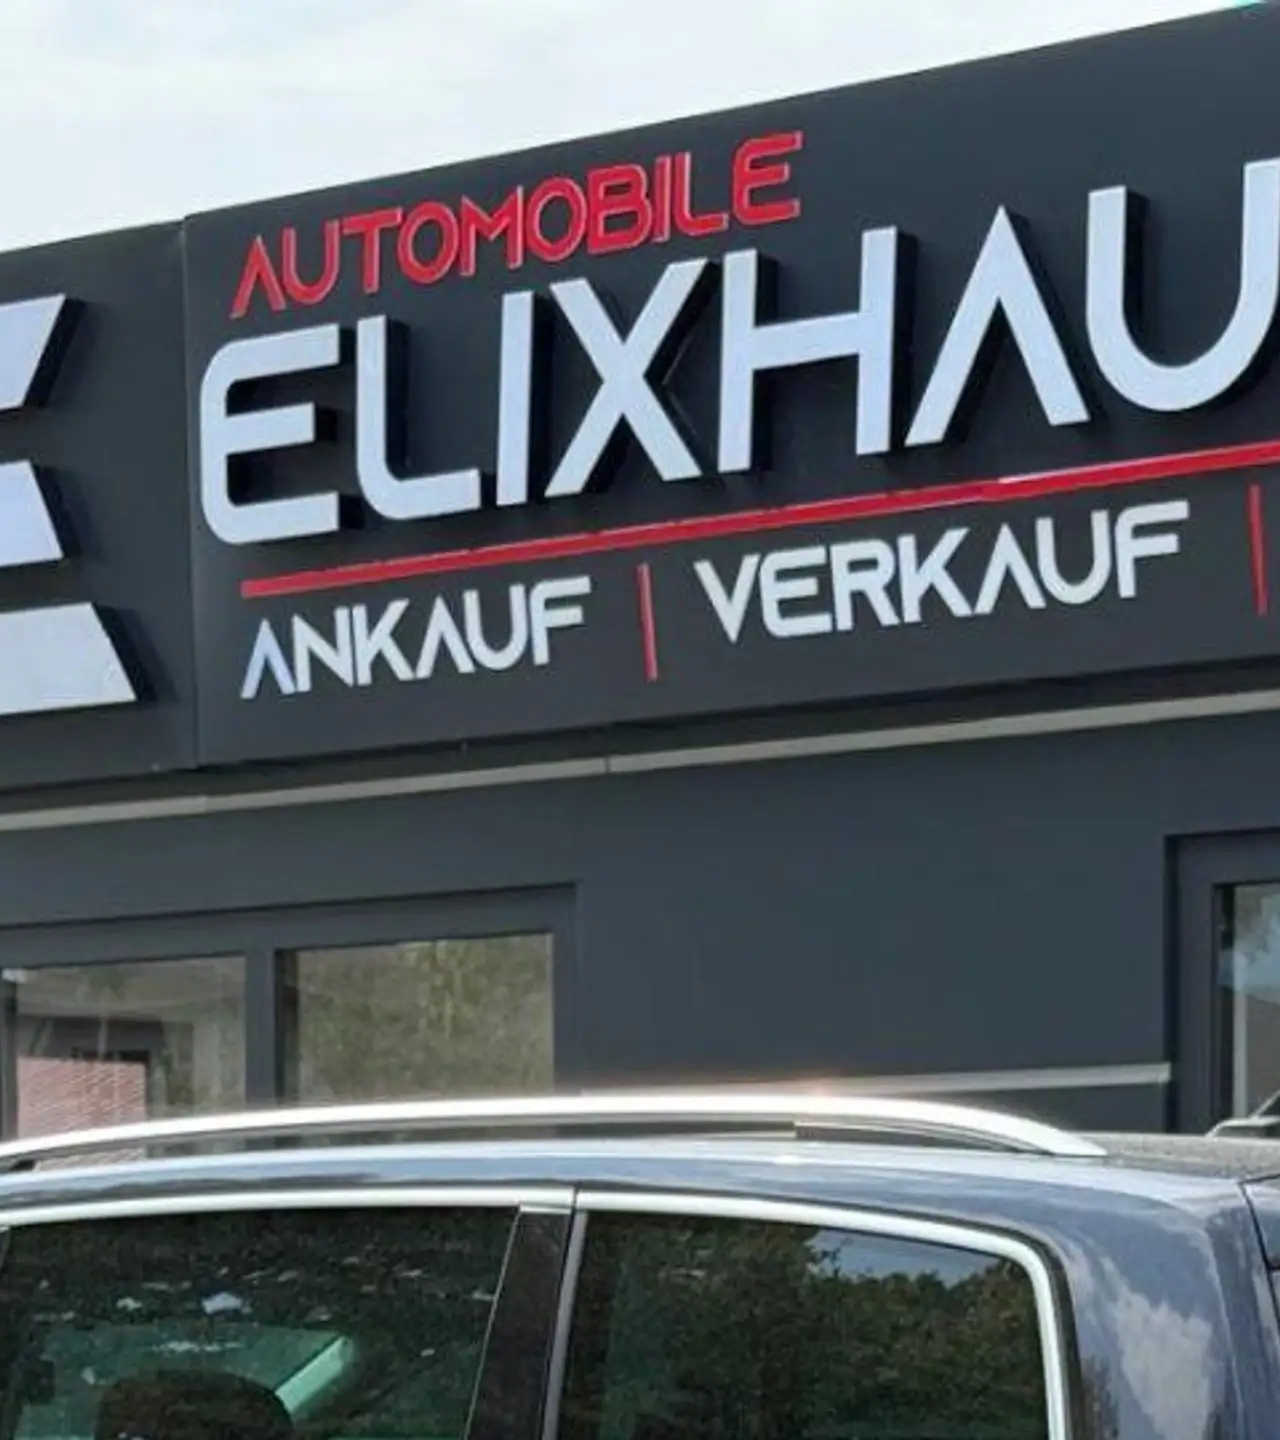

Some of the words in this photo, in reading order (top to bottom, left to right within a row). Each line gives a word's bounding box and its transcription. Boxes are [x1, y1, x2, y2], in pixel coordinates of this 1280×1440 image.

[230, 130, 803, 319] AUTOMOBILE
[240, 575, 591, 699] ANKAUF
[694, 500, 1190, 643] VERKAUF
